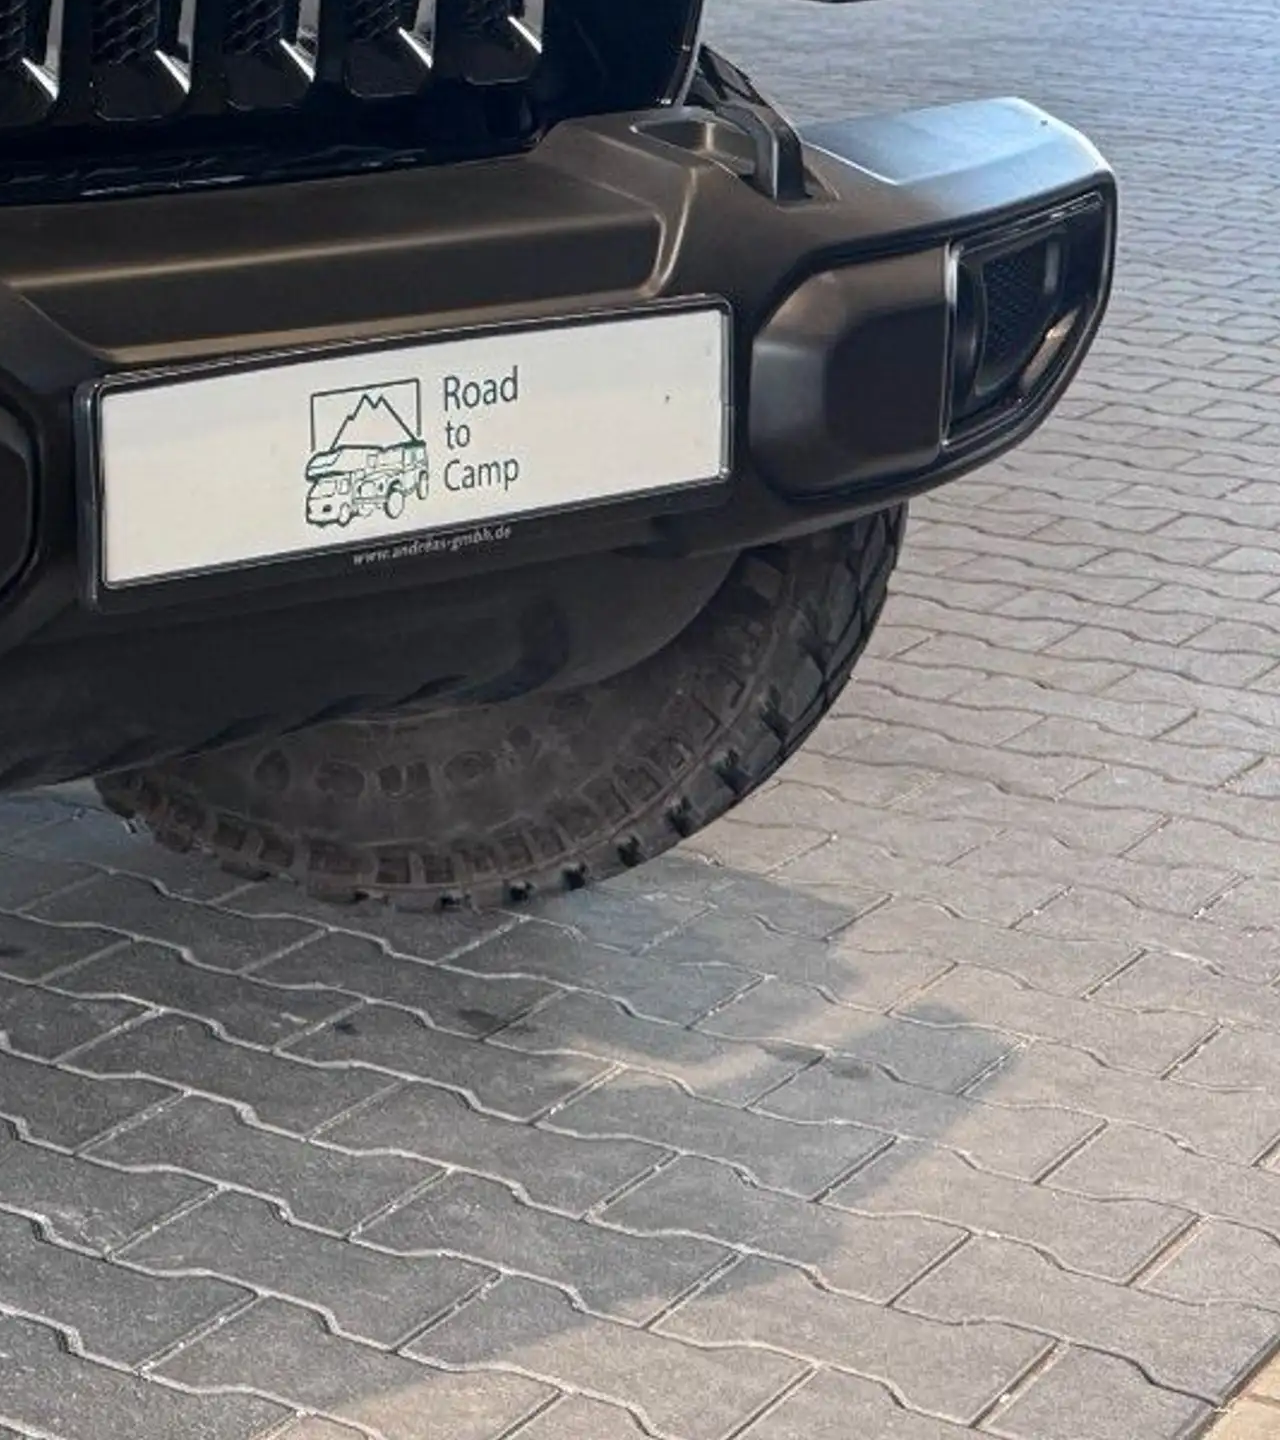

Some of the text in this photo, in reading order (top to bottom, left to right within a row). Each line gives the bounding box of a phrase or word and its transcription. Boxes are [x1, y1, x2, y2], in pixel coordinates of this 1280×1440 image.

[443, 364, 519, 412] Road
[445, 419, 471, 451] to
[443, 457, 519, 492] Camp
